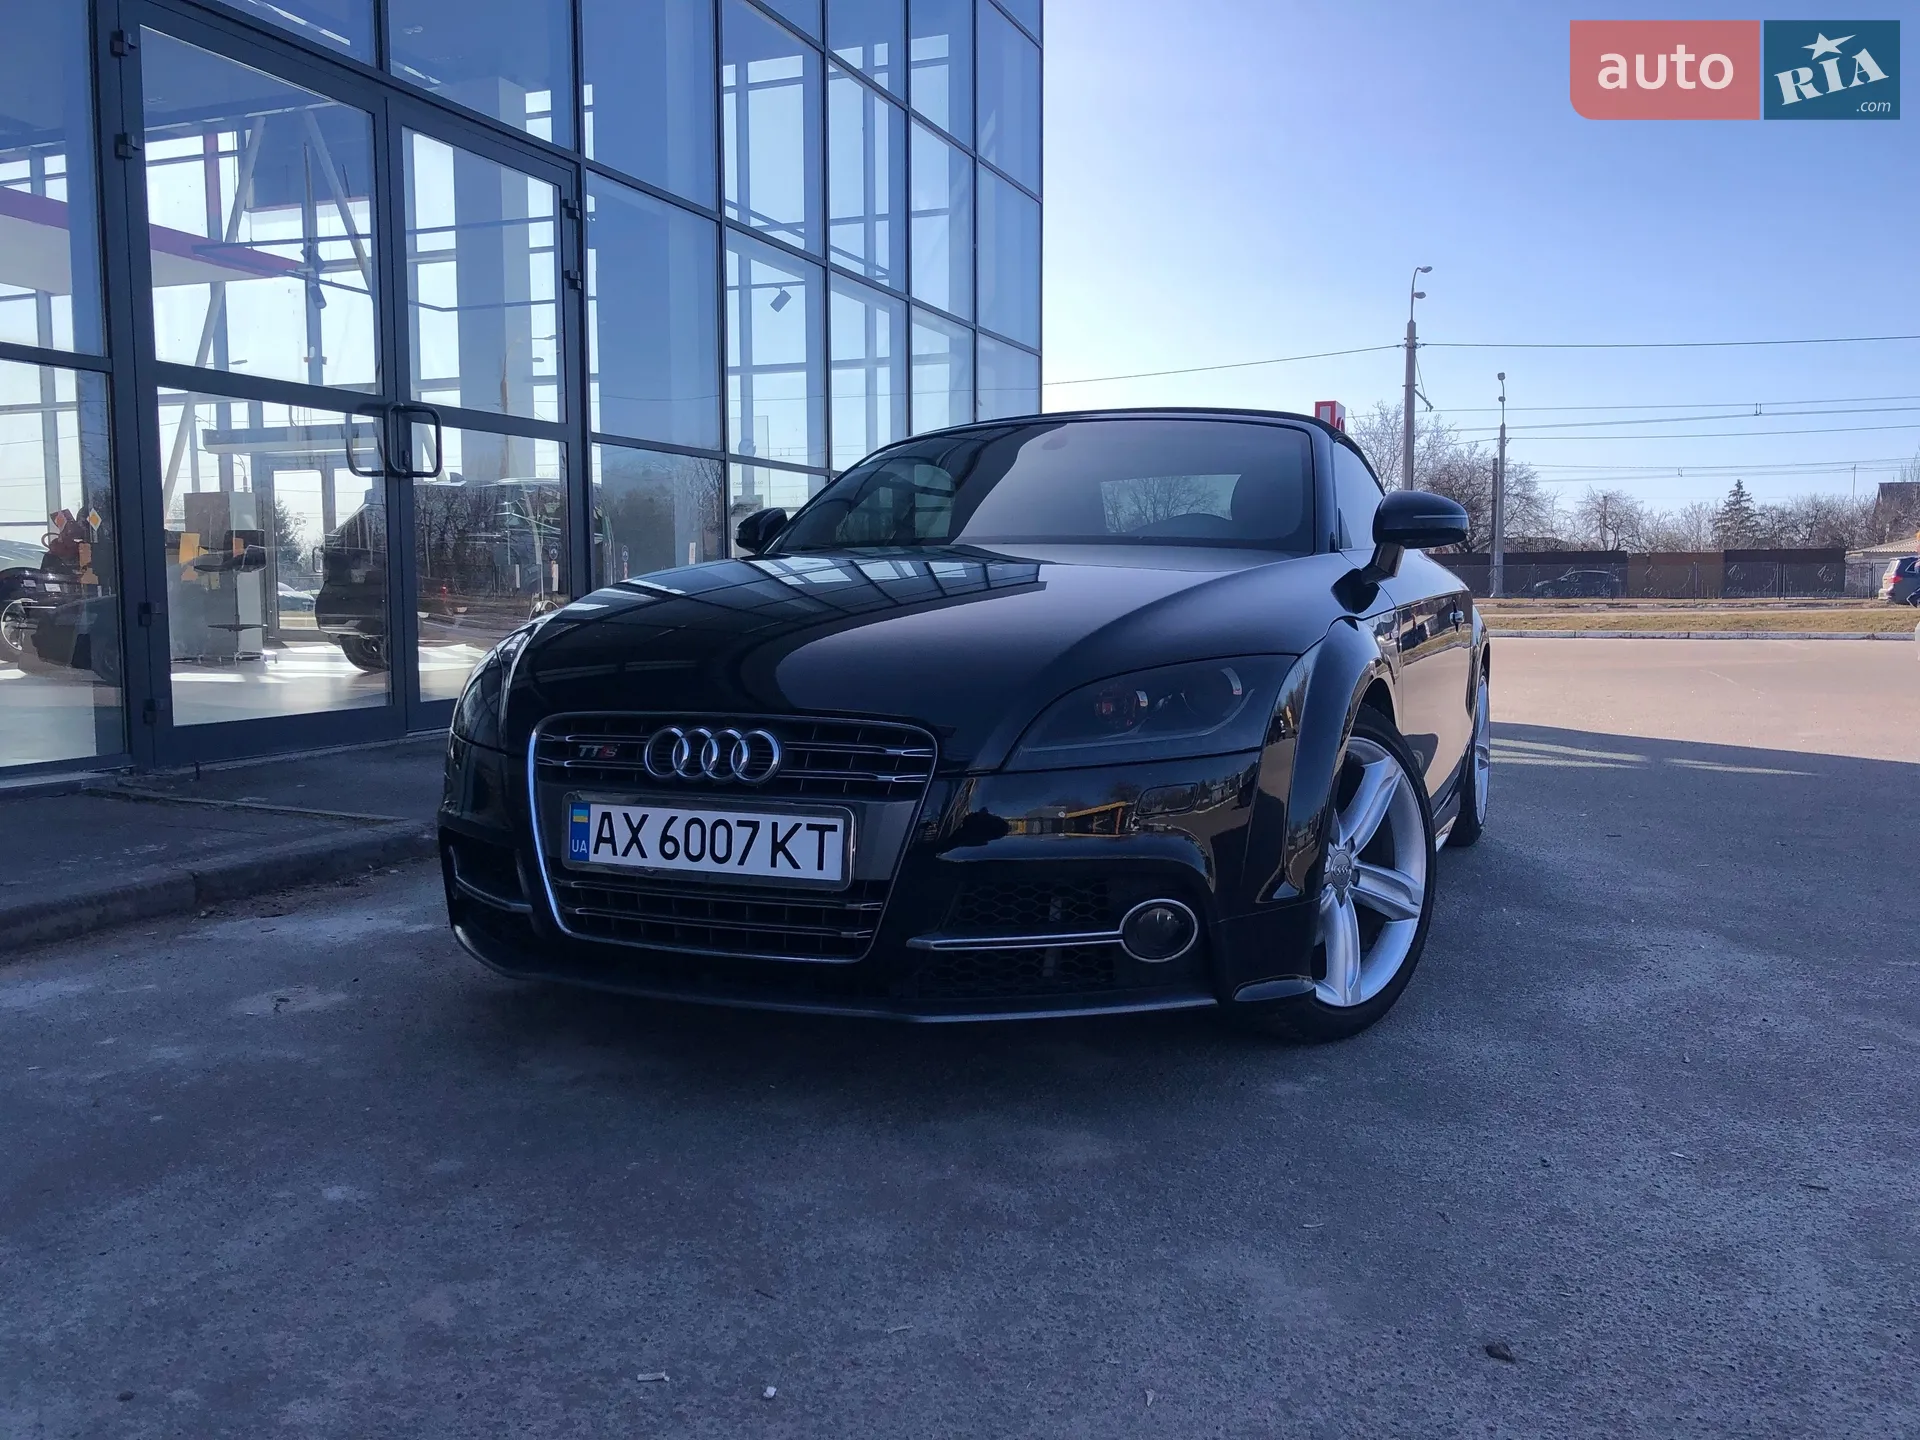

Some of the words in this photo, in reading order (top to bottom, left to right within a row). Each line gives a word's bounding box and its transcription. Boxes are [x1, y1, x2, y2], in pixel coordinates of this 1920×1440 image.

[579, 744, 619, 758] TTS
[572, 839, 588, 854] UA
[593, 811, 649, 859] AX
[659, 815, 760, 866] 6007
[770, 821, 838, 871] KT
